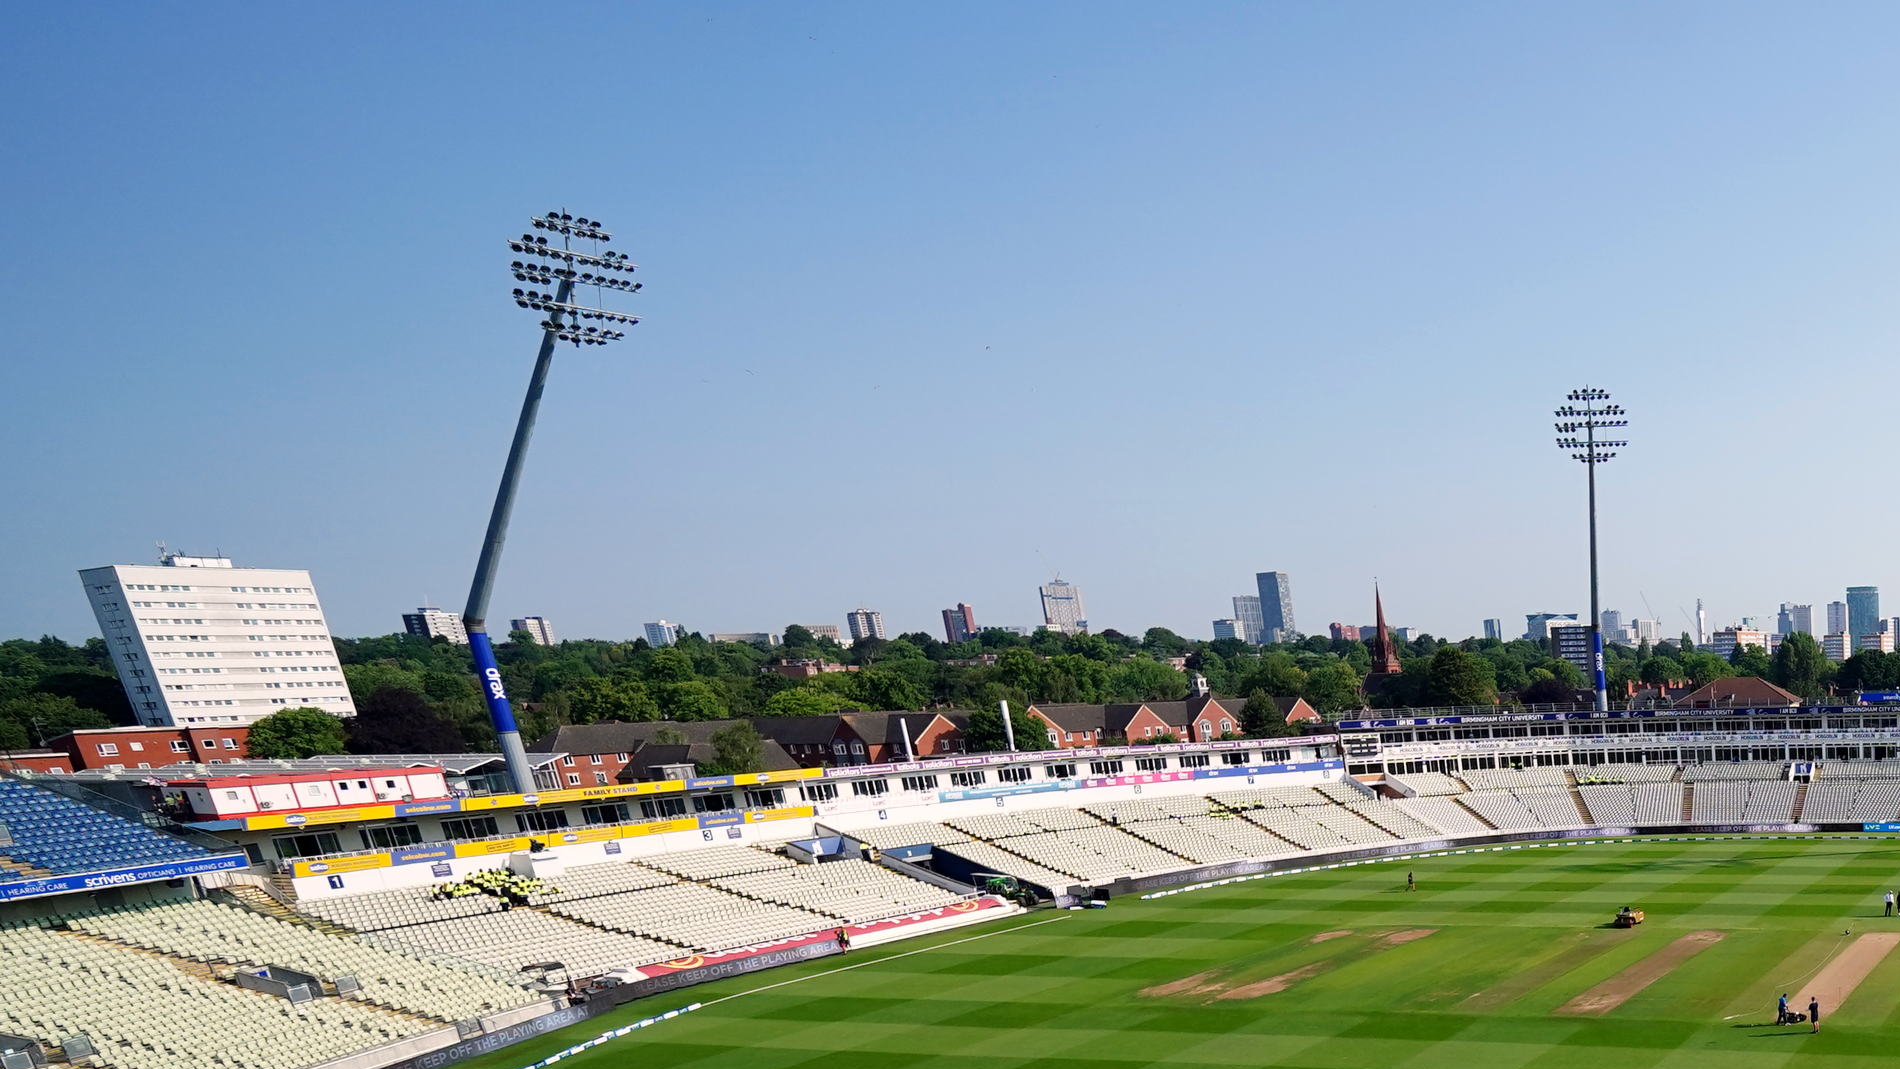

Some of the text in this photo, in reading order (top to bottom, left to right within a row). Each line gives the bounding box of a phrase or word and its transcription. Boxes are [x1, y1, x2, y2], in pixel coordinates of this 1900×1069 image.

[1595, 653, 1603, 671] drax
[486, 668, 506, 699] drax
[1512, 714, 1544, 722] UNIVERSITY
[1102, 747, 1128, 755] solicitors
[988, 752, 1041, 763] talbots solicitors
[896, 760, 952, 771] talbots solicitors
[830, 768, 860, 776] solicitors
[524, 786, 638, 803] selco FAMILY STAND
[405, 804, 451, 812] selcobw.com
[286, 815, 306, 824] selco
[880, 811, 886, 819] 4
[704, 831, 712, 840] 3
[309, 864, 329, 872] selco
[85, 860, 236, 888] scrivens OPTICIANS HEARING CARE
[333, 877, 342, 888] 1
[8, 882, 67, 896] HEARING CARE
[634, 974, 676, 994] PLEASE
[677, 966, 709, 985] KEEP
[710, 963, 732, 976] OFF
[736, 957, 759, 971] THE
[762, 947, 807, 965] PLAYING
[809, 941, 838, 956] AREA
[415, 1054, 447, 1069] KEEP
[449, 1044, 473, 1060] OFF
[476, 1035, 498, 1052] THE
[500, 1021, 544, 1044] PLAYING
[546, 1010, 575, 1027] AREA
[577, 1005, 589, 1017] AT
